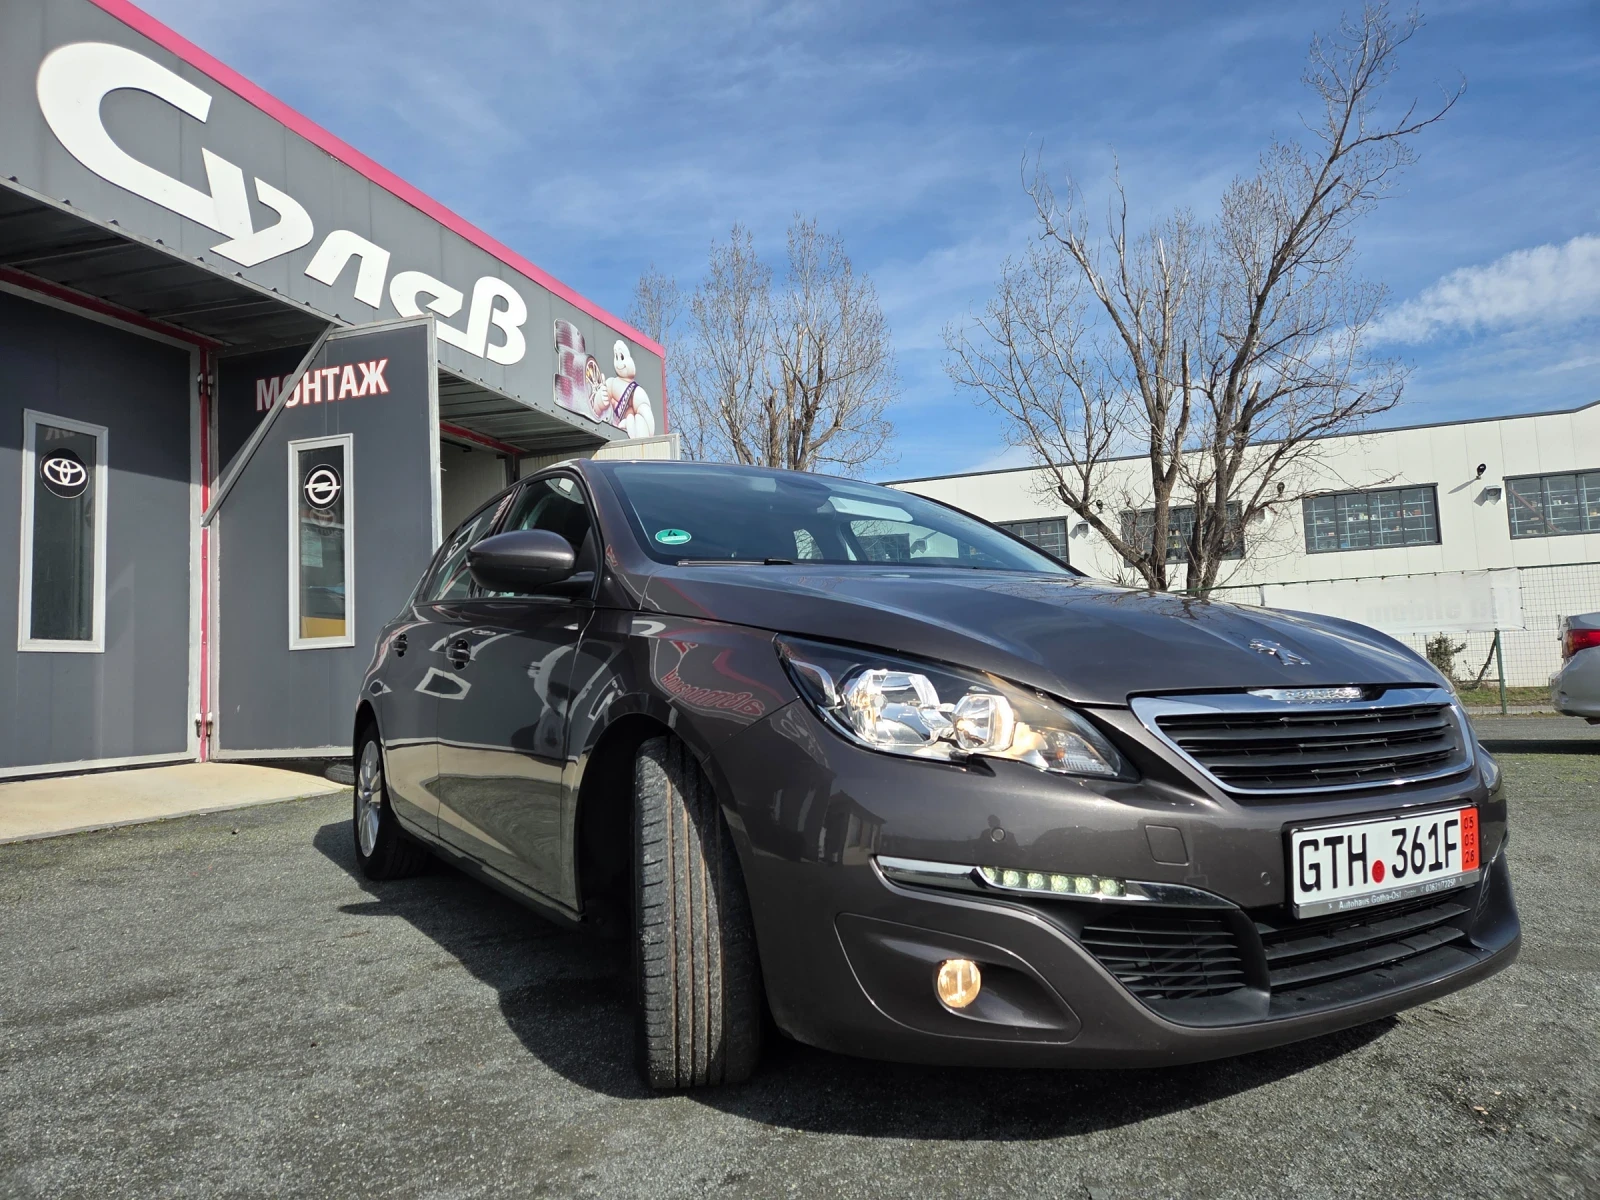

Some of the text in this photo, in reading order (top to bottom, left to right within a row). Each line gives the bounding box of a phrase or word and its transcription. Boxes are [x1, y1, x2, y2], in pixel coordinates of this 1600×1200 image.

[1463, 816, 1474, 830] 05
[1464, 833, 1474, 846] 03
[1298, 819, 1459, 892] GTH 361F
[1464, 849, 1475, 863] 26
[1338, 897, 1370, 910] Autohaus
